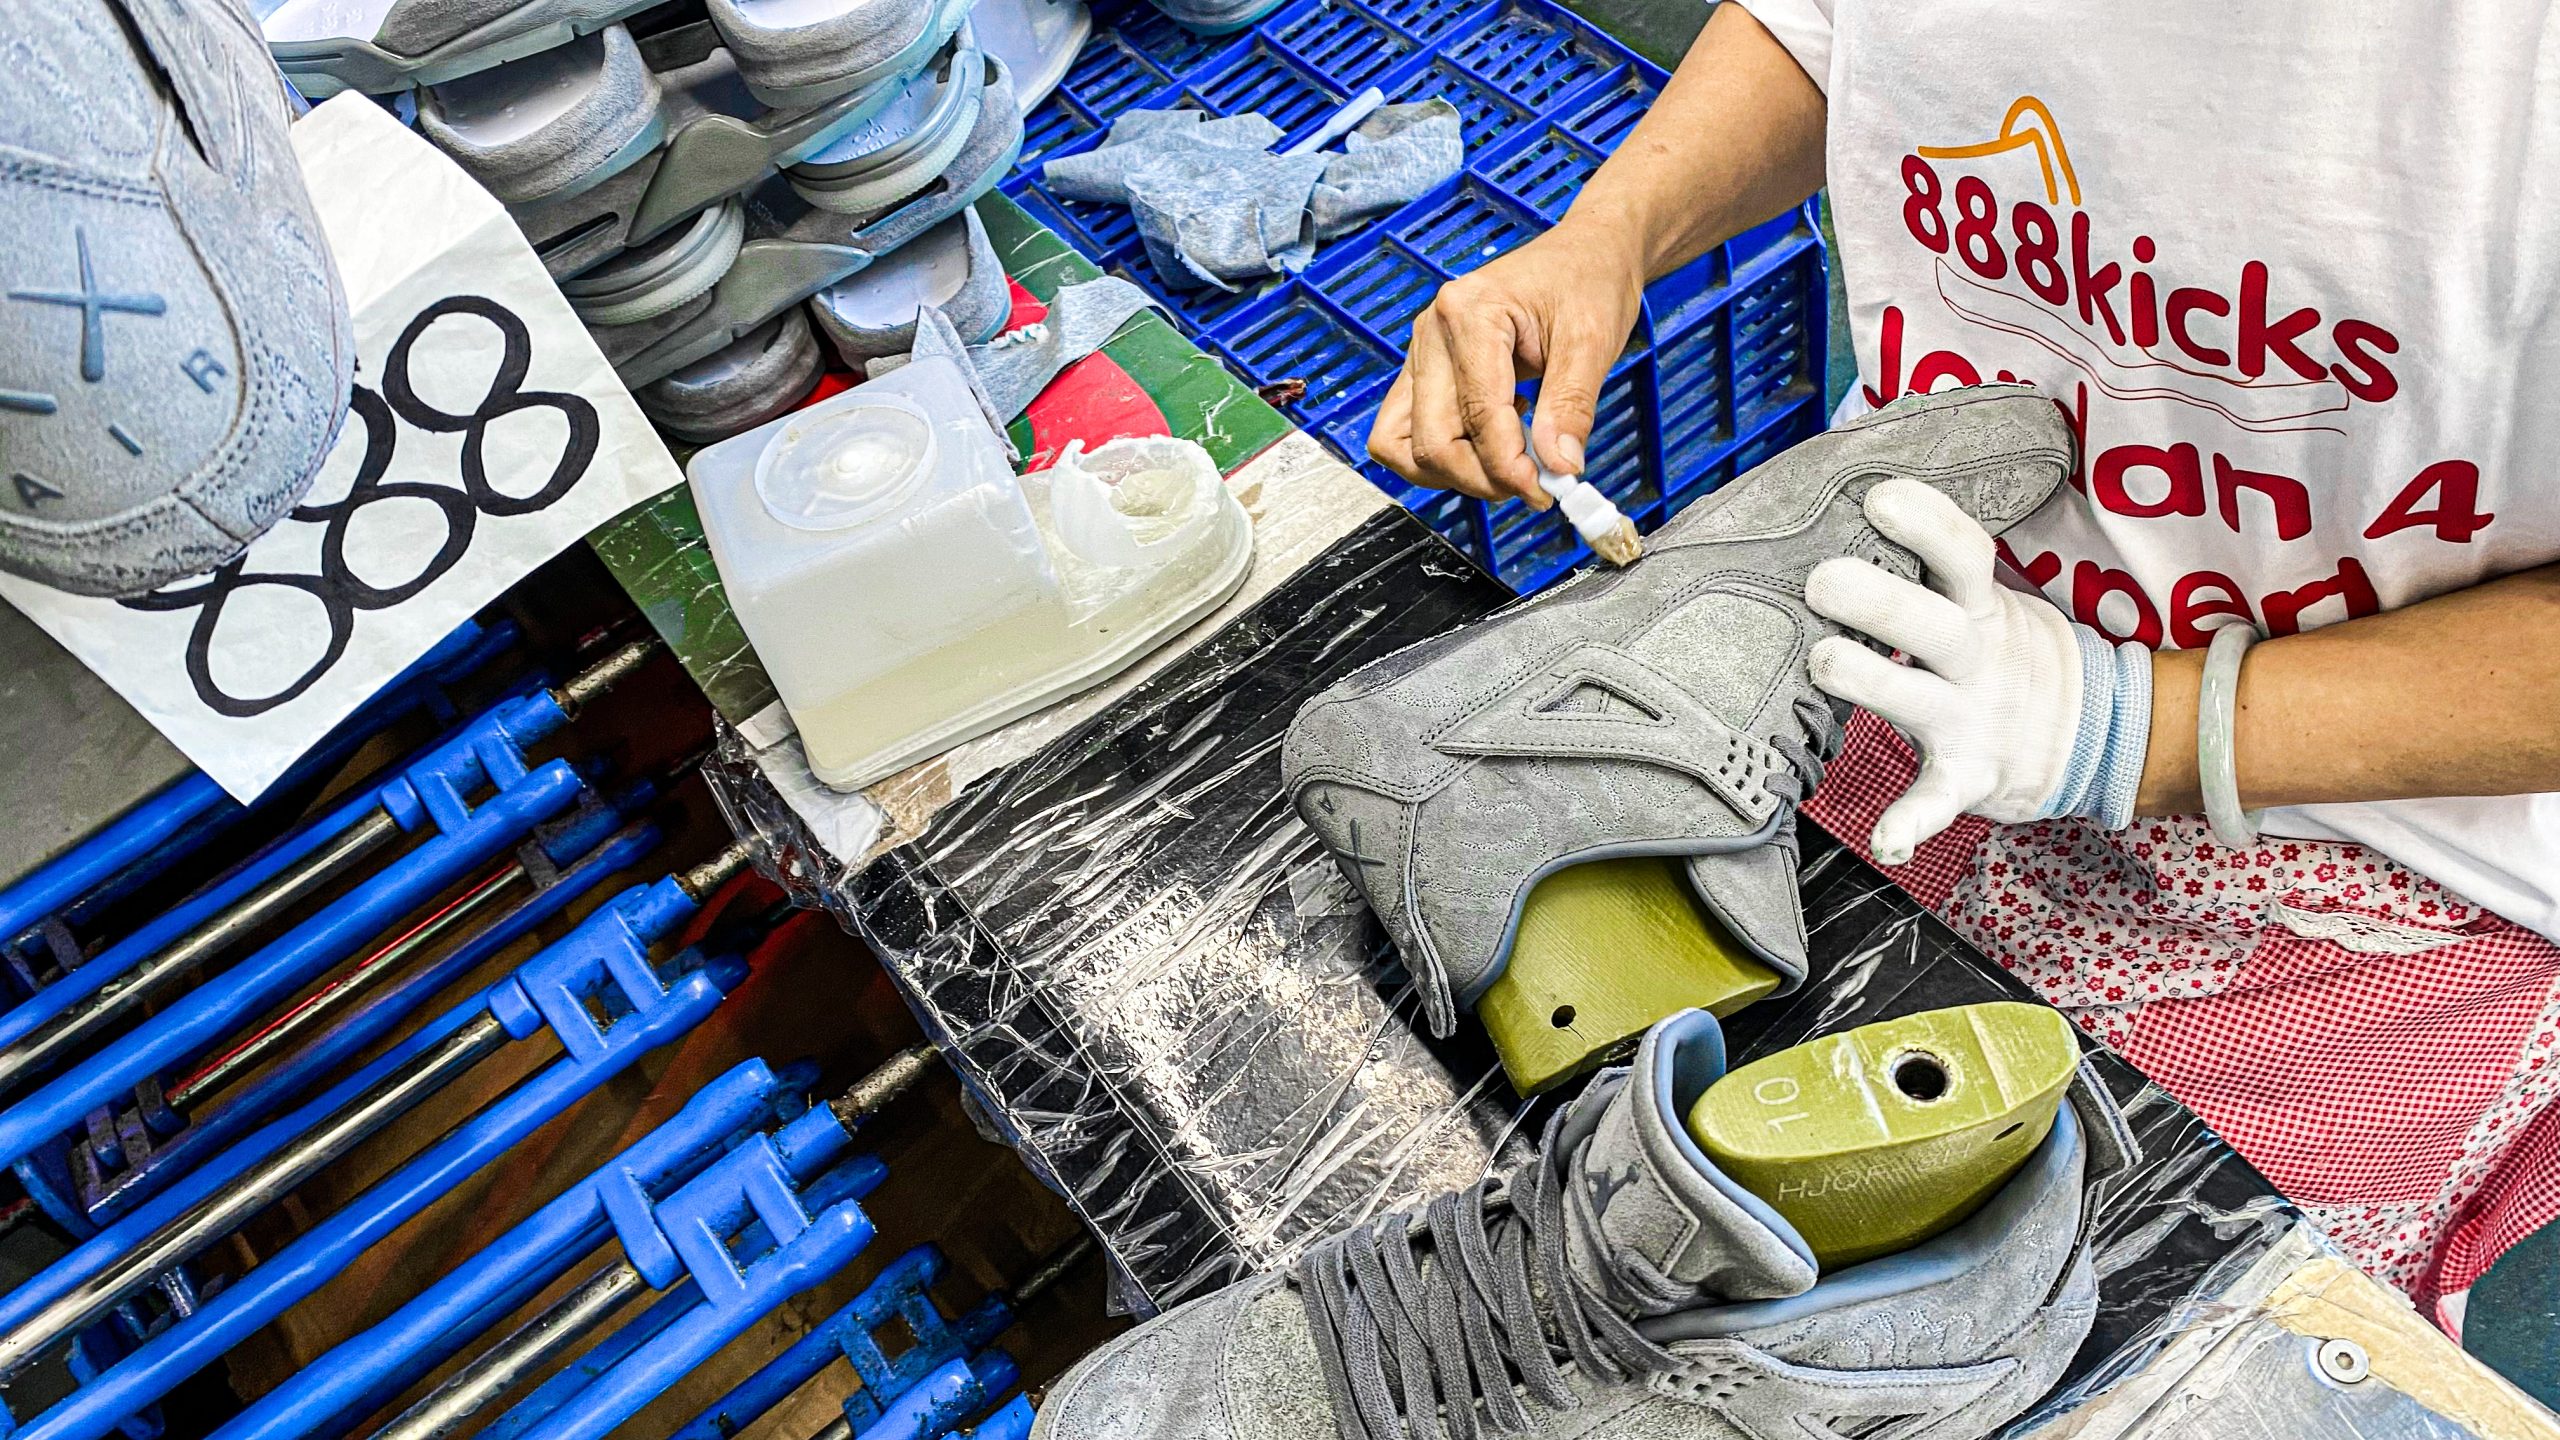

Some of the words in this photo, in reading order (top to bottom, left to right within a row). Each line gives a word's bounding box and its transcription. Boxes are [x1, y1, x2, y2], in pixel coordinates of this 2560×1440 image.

[1901, 154, 2400, 404] 888kicks
[2363, 459, 2495, 543] 4
[1753, 1076, 1810, 1134] 10
